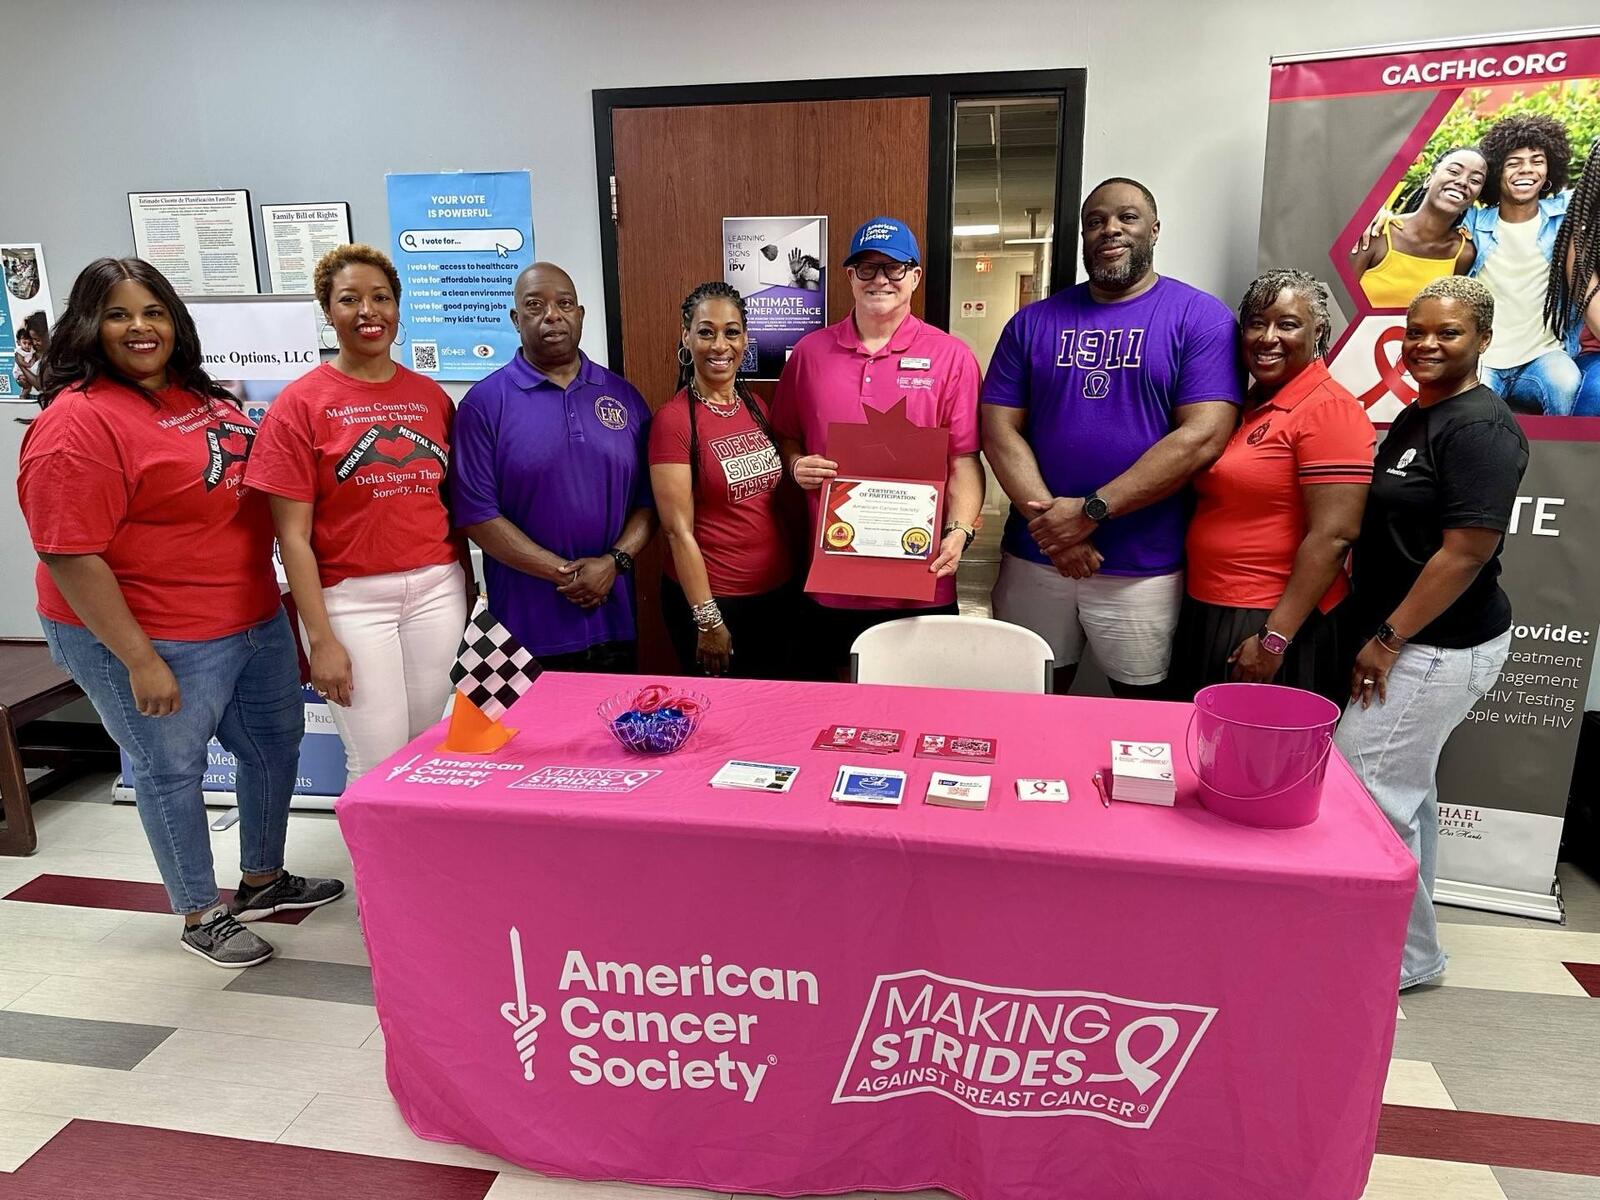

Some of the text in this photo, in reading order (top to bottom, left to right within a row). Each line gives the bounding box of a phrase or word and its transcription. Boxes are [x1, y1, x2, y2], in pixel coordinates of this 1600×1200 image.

[1381, 52, 1567, 86] GACFHC.ORG
[431, 195, 486, 205] YOUR VOTE
[272, 212, 294, 222] Family
[295, 212, 307, 220] Bill
[316, 211, 338, 221] Rights
[428, 209, 492, 218] IS POWERFUL.
[476, 262, 519, 270] healthcare
[729, 264, 745, 272] IPV
[429, 276, 440, 284] for
[441, 276, 480, 284] affordable
[481, 275, 512, 285] housing
[448, 289, 469, 297] clean
[443, 303, 461, 312] good
[463, 303, 490, 312] paying
[490, 302, 507, 312] jobs
[747, 297, 803, 307] INTIMATE
[775, 307, 821, 315] VIOLENCE
[444, 317, 457, 325] my
[457, 315, 475, 323] kids'
[477, 315, 501, 323] future
[1056, 329, 1145, 370] 1911
[229, 351, 281, 366] Options,
[284, 351, 314, 363] LLC
[326, 402, 429, 419] Madison County (MS)
[158, 411, 193, 429] Madison
[178, 416, 211, 435] Alumnae
[341, 412, 423, 427] Alumnae Chapter
[223, 423, 256, 435] MENTAL
[398, 426, 430, 448] MENTAL
[337, 428, 380, 479] PHYSICAL HEALTH
[208, 451, 223, 485] PHYSICAL
[354, 475, 385, 486] Delta
[386, 473, 417, 484] Sigma
[372, 484, 434, 499] Sorority, Inc.
[1484, 690, 1575, 712] HIV Testing
[1504, 711, 1537, 725] with
[1543, 714, 1573, 729] HIV
[424, 758, 524, 771] American
[414, 766, 492, 779] Cancer
[543, 768, 623, 779] MAKING
[404, 774, 484, 788] Society
[528, 776, 612, 787] STRIDES
[1438, 806, 1482, 822] HAEL
[559, 950, 820, 1005] American
[560, 997, 758, 1045] Cancer
[885, 984, 1112, 1044] MAKING
[870, 1027, 1087, 1087] STRIDES
[856, 1067, 950, 1092] AGAINST
[954, 1079, 1035, 1107] BREAST
